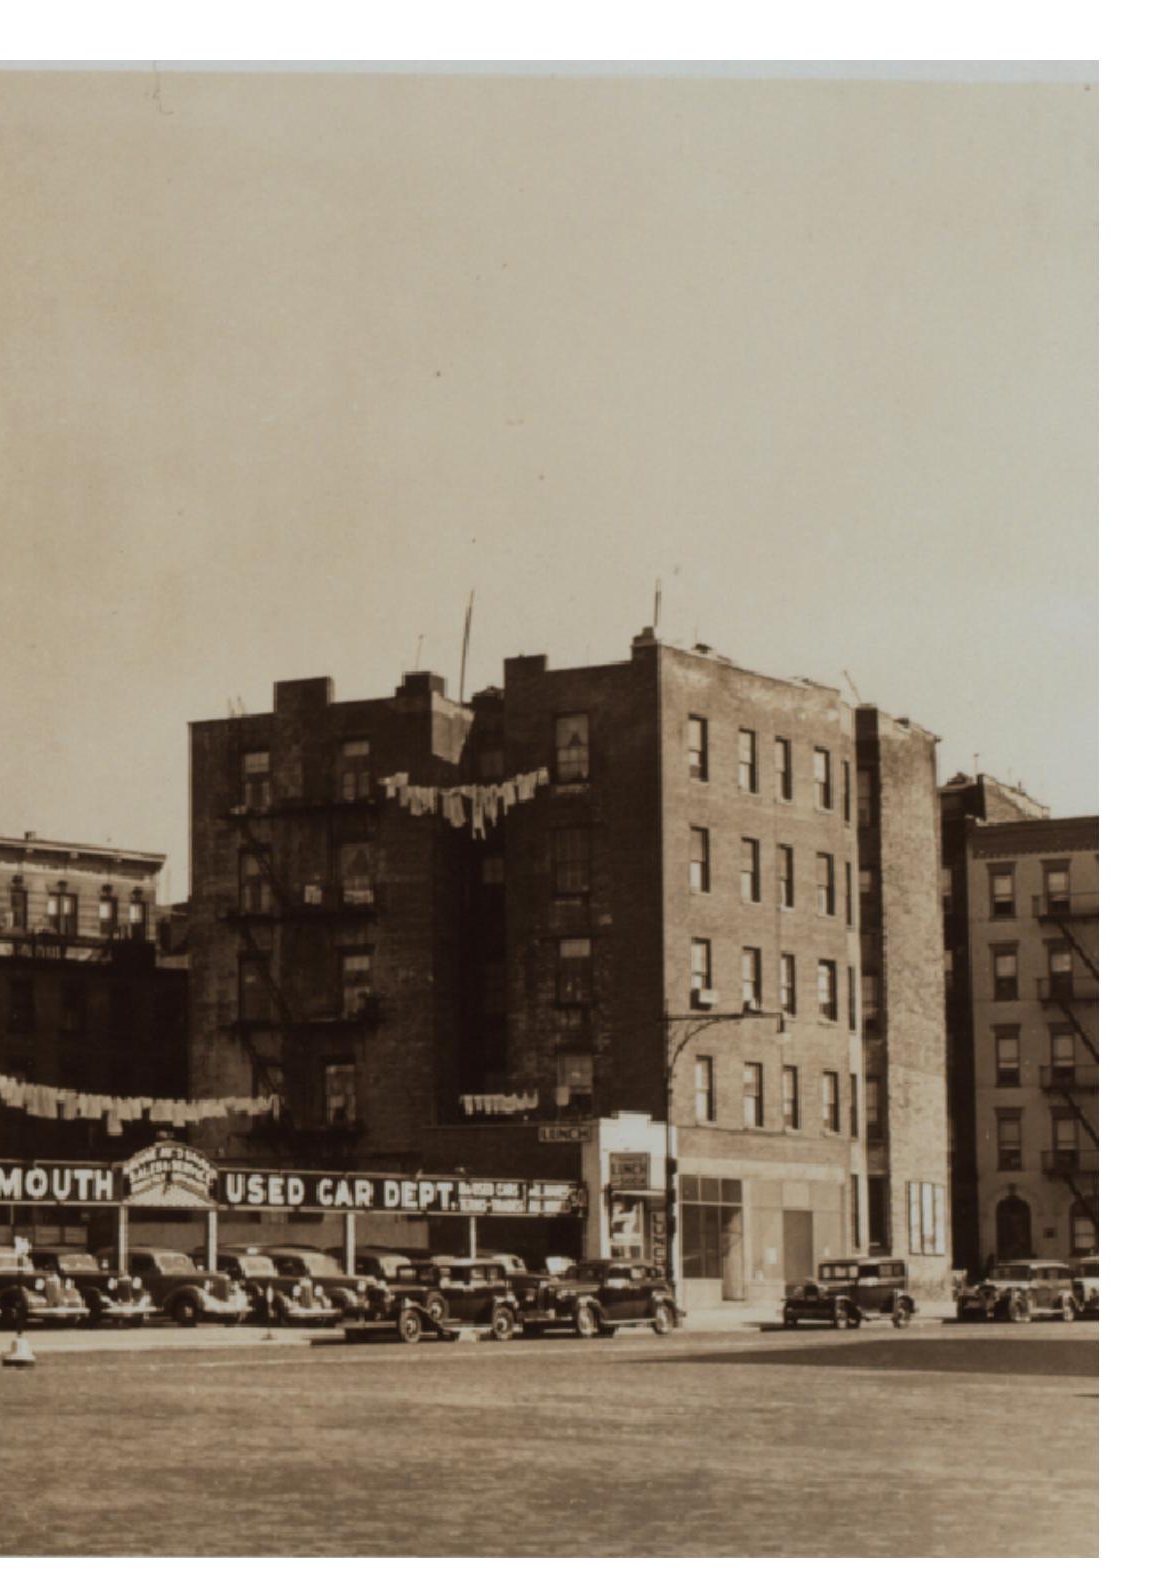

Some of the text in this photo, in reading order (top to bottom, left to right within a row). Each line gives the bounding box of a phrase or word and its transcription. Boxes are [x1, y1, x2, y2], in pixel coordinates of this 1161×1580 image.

[226, 1173, 305, 1206] USED
[317, 1177, 375, 1208] CAR
[383, 1180, 458, 1212] DEPT.
